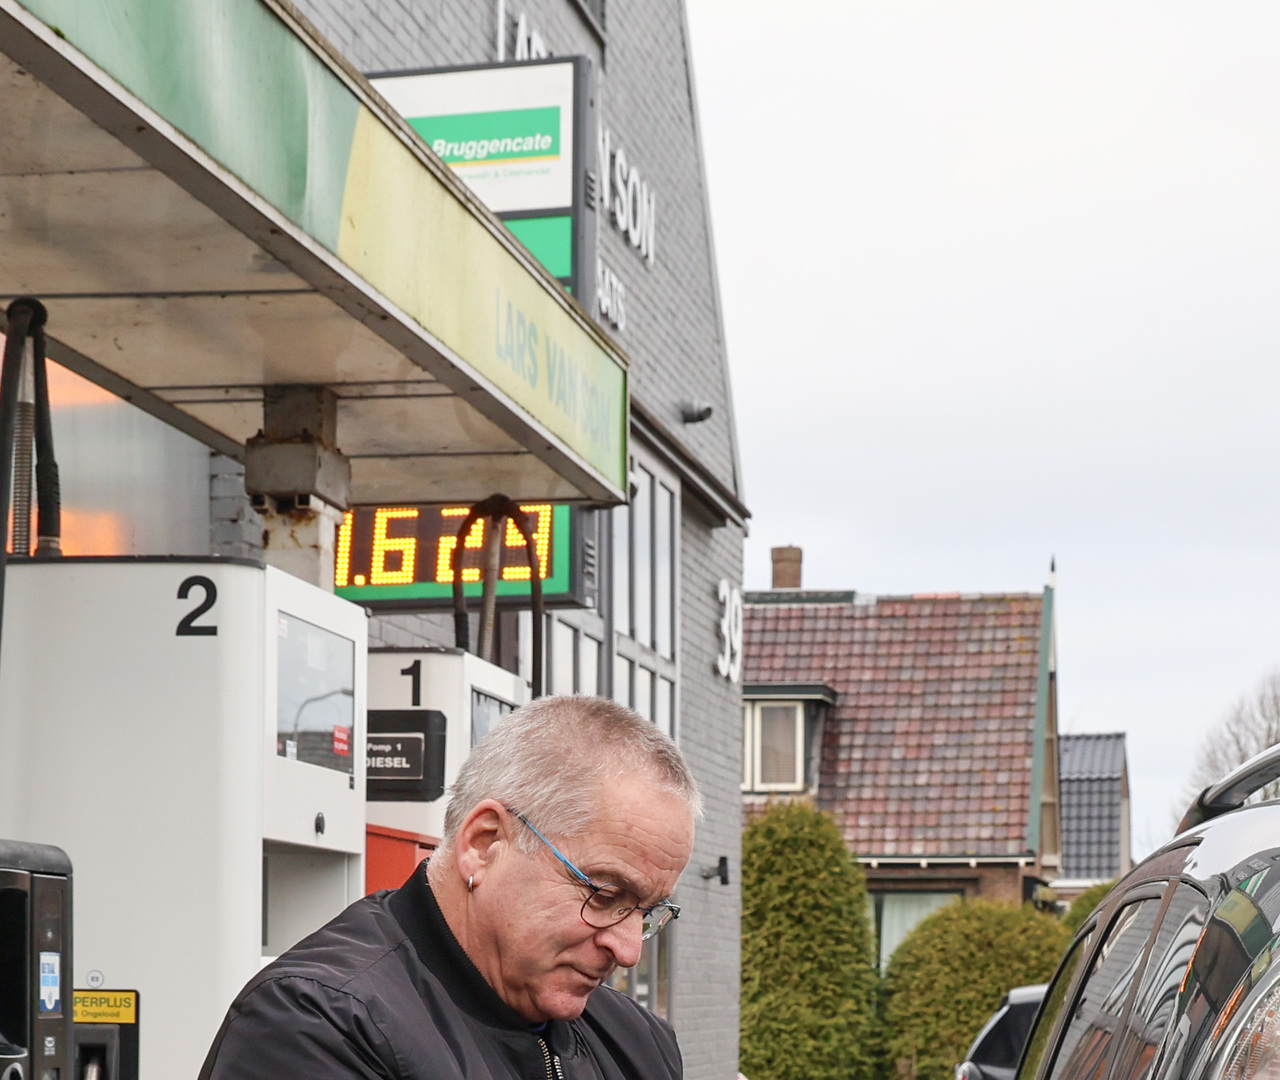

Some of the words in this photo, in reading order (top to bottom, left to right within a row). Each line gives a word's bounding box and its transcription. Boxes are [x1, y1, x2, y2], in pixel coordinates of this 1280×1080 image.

[431, 132, 553, 161] Bruggencate
[615, 147, 655, 266] SON
[496, 288, 539, 390] LARS
[176, 575, 218, 636] 2
[718, 578, 742, 683] 39
[400, 660, 422, 706] 1
[366, 757, 410, 768] DIESEL
[367, 743, 392, 753] Pomp
[396, 743, 402, 751] 1
[73, 996, 132, 1009] PERPLUS
[81, 1010, 120, 1019] Ongelood
